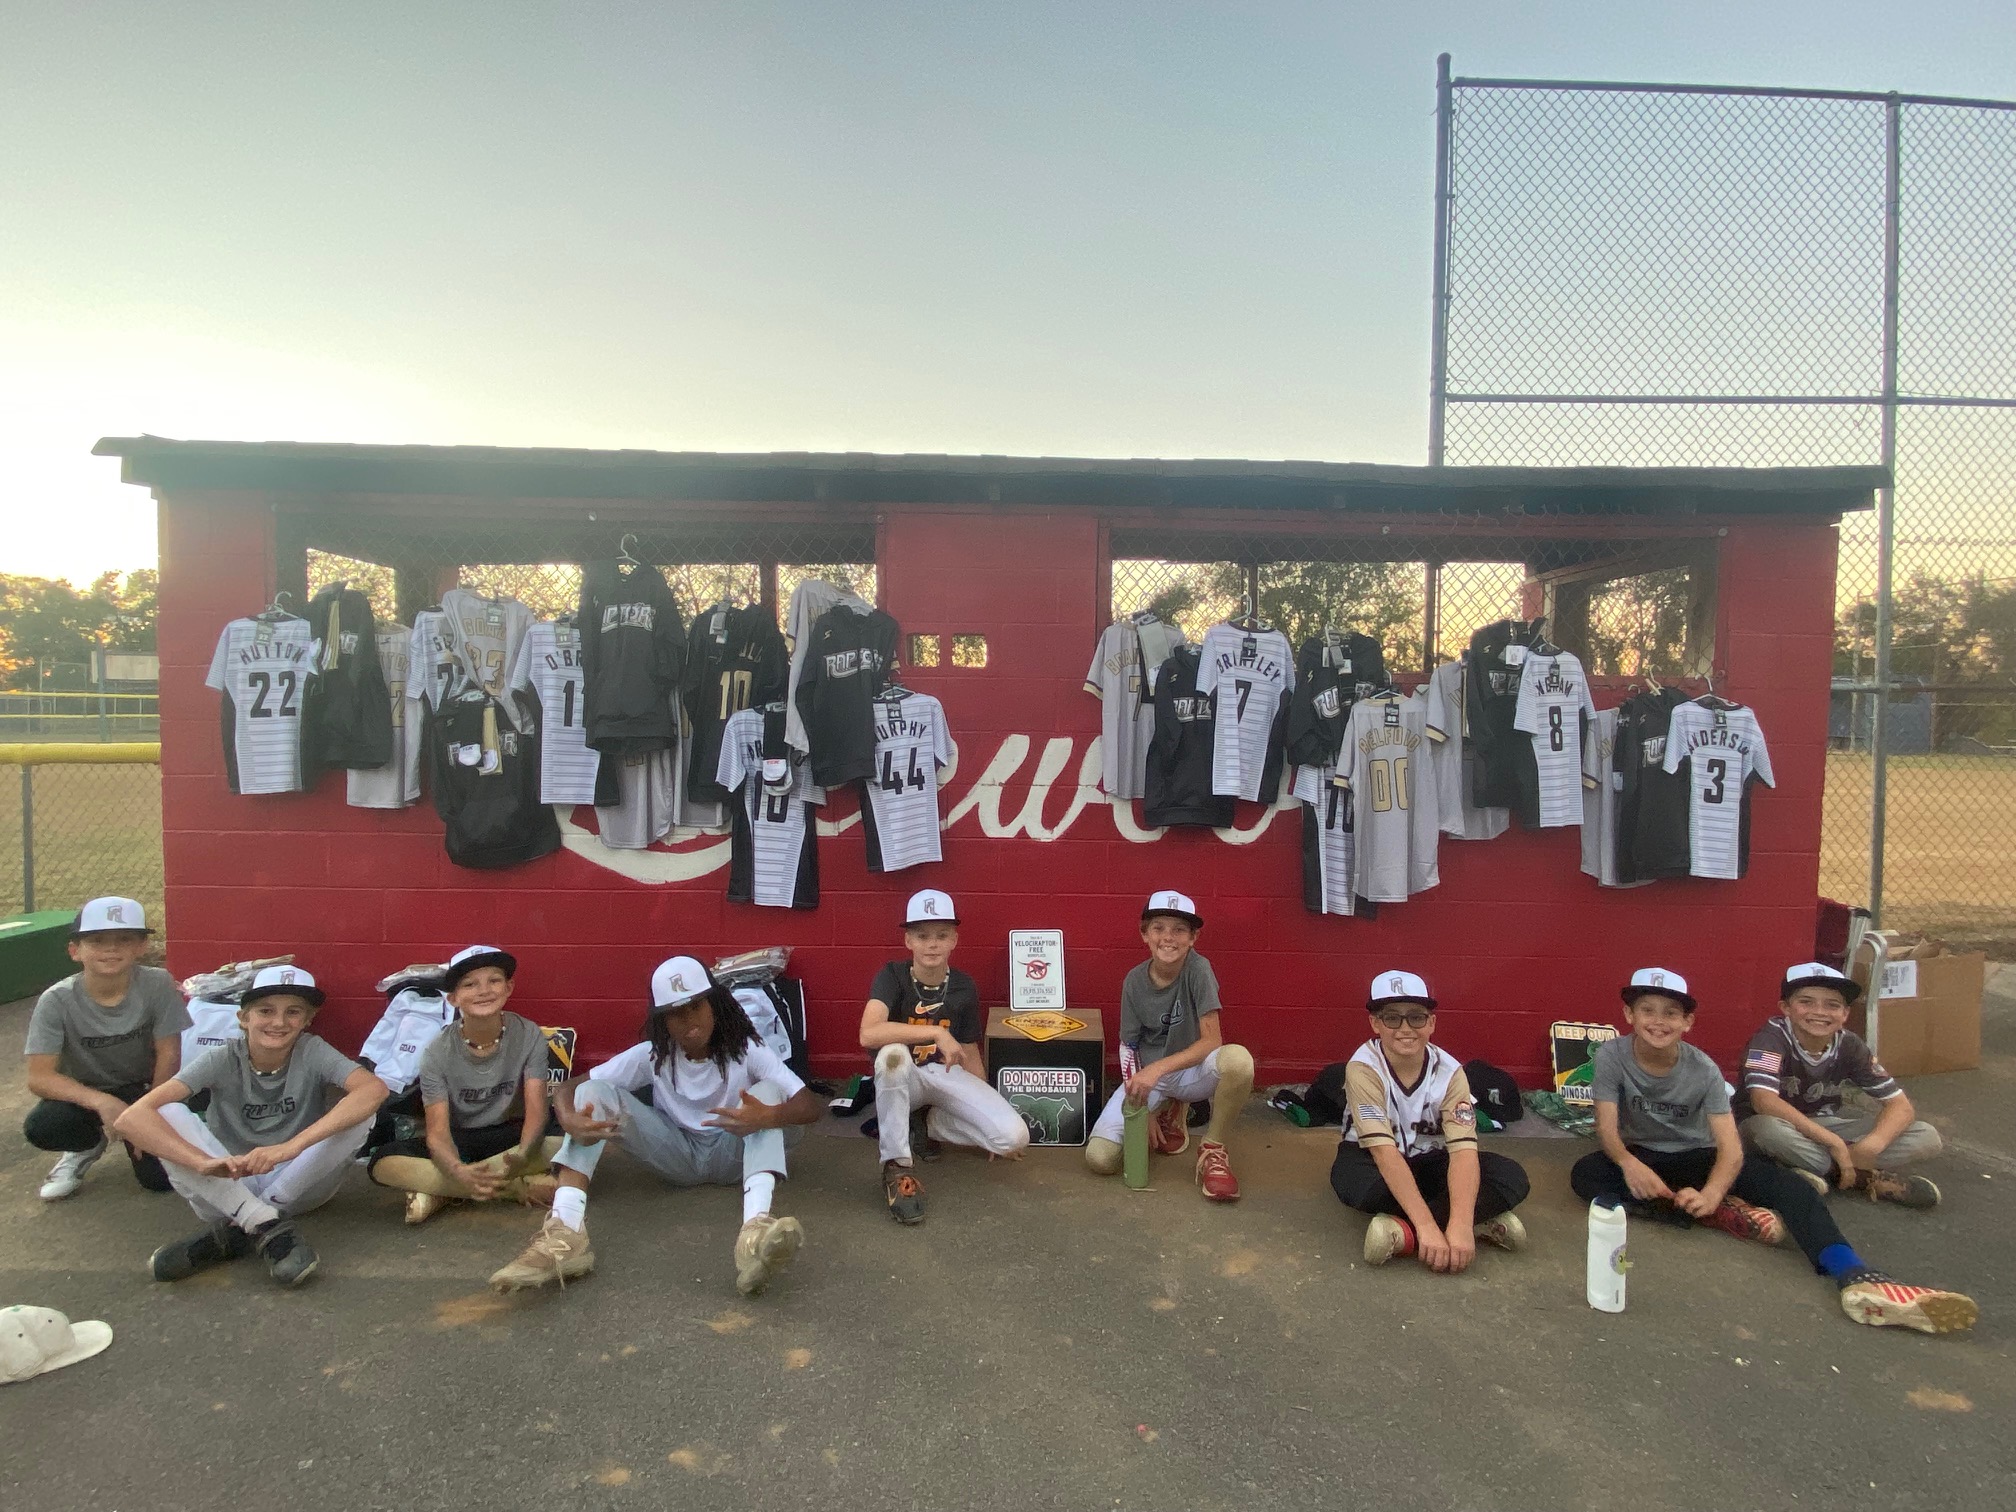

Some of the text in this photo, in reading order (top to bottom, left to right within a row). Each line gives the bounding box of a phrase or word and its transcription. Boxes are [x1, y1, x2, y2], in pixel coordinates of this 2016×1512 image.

[249, 670, 298, 718] 22
[720, 670, 753, 720] 10
[1235, 679, 1252, 725] 7
[1549, 705, 1563, 752] 8
[882, 747, 926, 795] 44
[1704, 758, 1727, 804] 3
[197, 1037, 226, 1047] HUTTO
[1556, 1026, 1586, 1040] KEEP
[1003, 1071, 1080, 1086] DO NOT FEED
